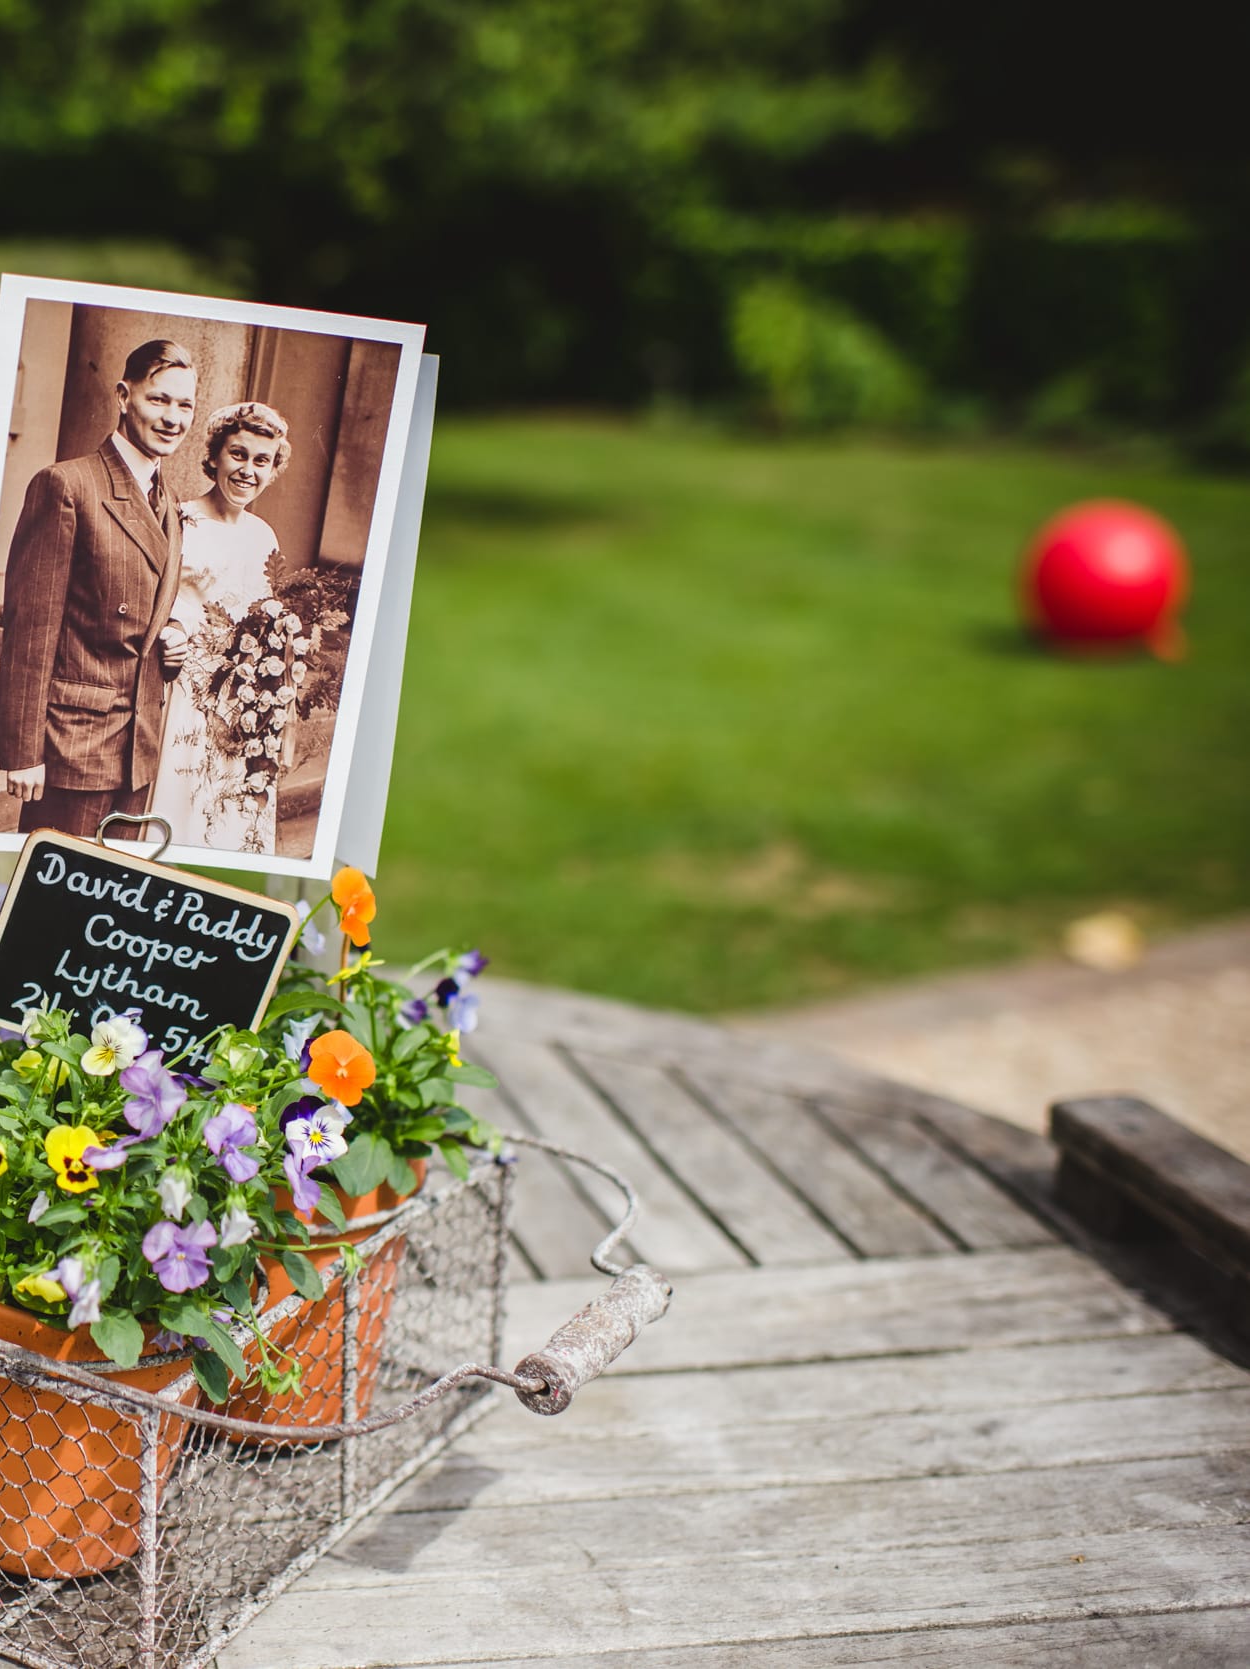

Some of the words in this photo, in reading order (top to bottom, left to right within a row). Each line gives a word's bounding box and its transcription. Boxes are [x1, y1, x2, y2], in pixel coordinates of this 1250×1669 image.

[36, 853, 151, 913] David
[174, 892, 278, 962] Paddy
[84, 913, 218, 972] Cooper
[54, 949, 209, 1021] Lytham
